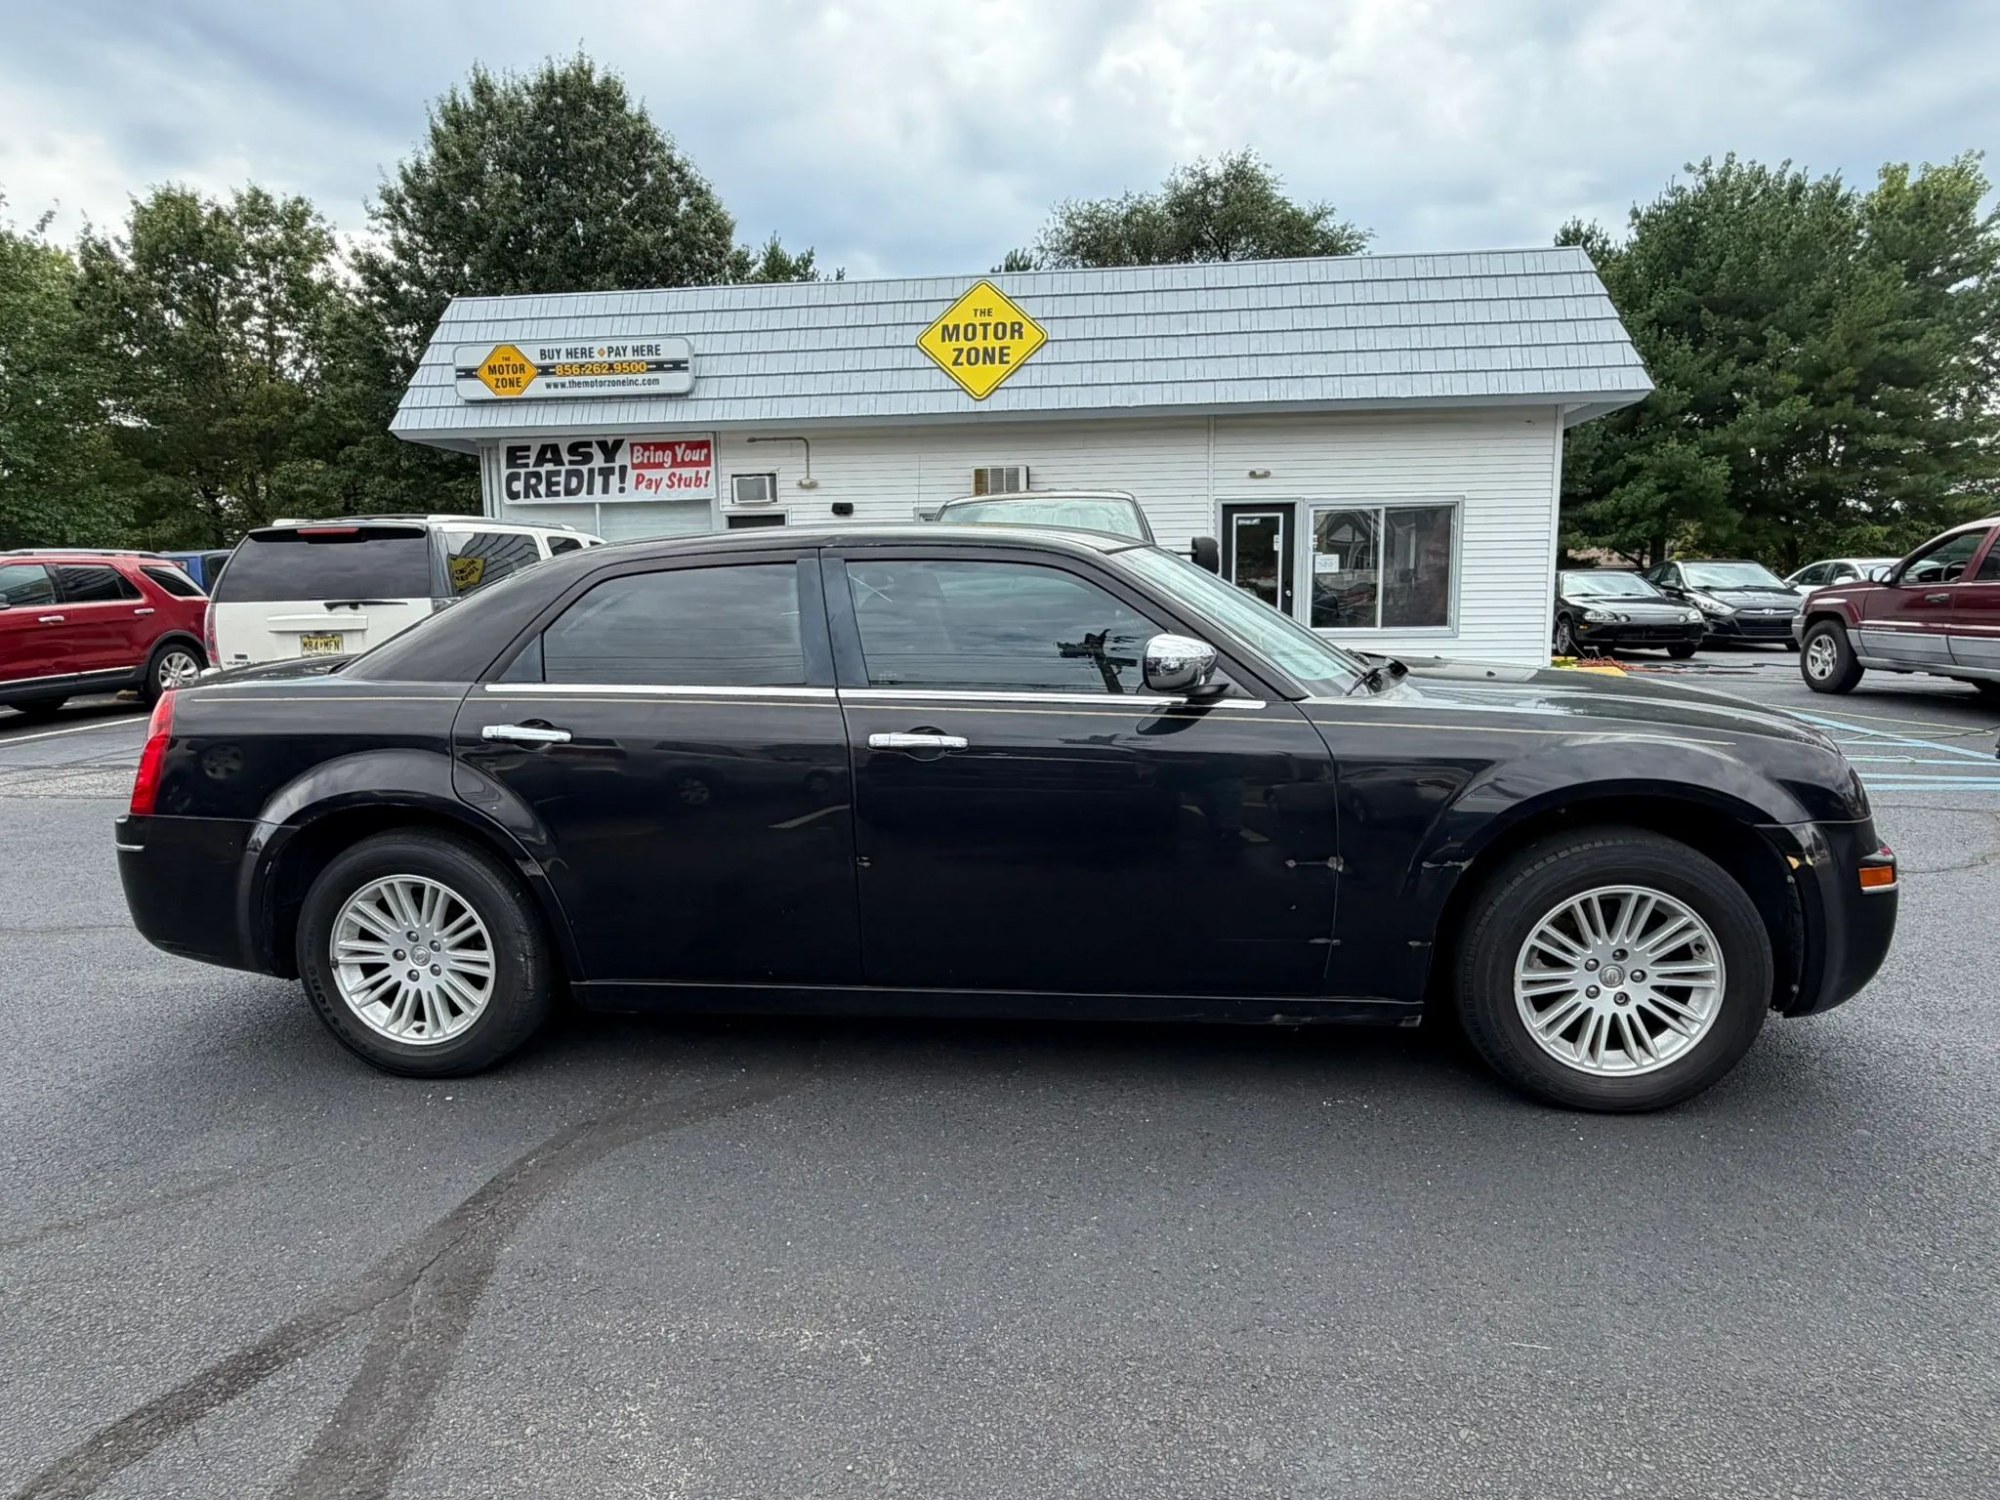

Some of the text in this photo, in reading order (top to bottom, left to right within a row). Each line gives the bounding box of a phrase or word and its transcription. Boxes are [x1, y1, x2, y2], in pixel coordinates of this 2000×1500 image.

[973, 308, 993, 317] THE
[941, 321, 1024, 343] MOTOR
[540, 344, 661, 360] BUY HERE PAY HERE
[952, 346, 1011, 367] ZONE
[487, 363, 526, 376] MOTOR
[494, 377, 522, 389] ZONE
[545, 377, 660, 389] www.themotorzoneinc.com
[505, 438, 626, 469] EASY
[632, 443, 708, 468] Bring Your
[505, 464, 628, 501] CREDIT!
[634, 470, 711, 495] Pay Stub!
